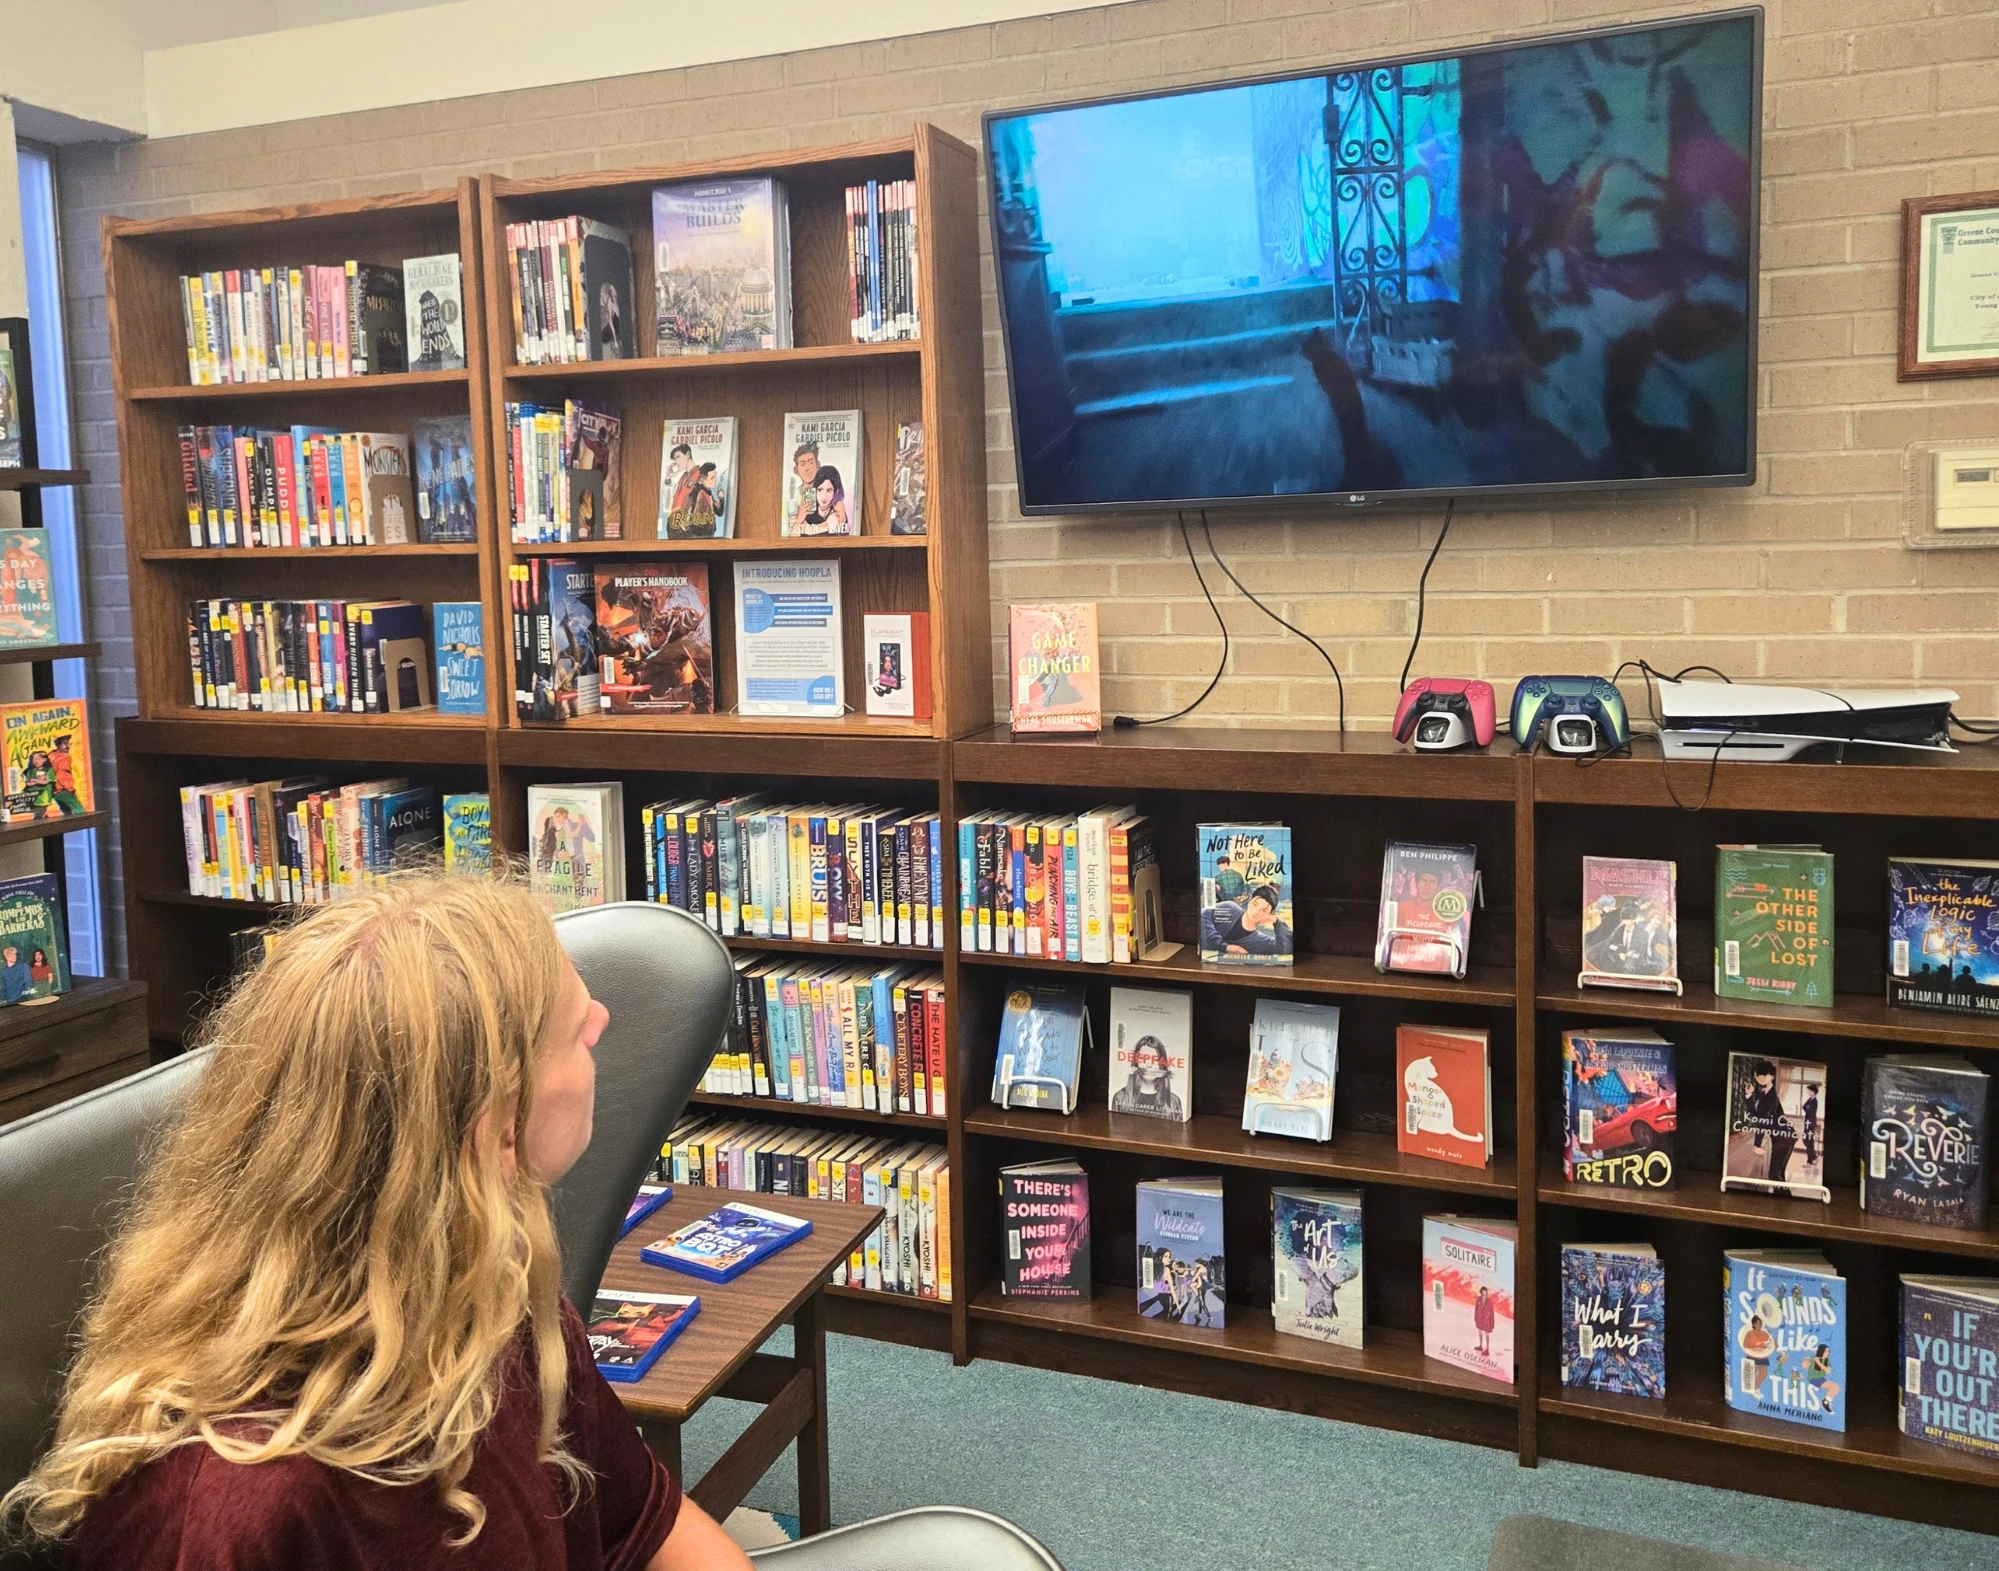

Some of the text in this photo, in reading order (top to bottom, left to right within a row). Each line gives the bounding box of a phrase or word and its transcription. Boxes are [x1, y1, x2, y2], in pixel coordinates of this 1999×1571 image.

[694, 187, 732, 197] MINECRAFT
[680, 197, 744, 213] MASTER
[686, 212, 741, 228] BUILDS
[1958, 229, 1984, 237] Greene
[407, 263, 453, 279] GERALDINE
[422, 308, 439, 320] THE
[421, 332, 450, 354] ENDS
[582, 414, 600, 428] CITY
[677, 424, 719, 436] KAMI GARCIA
[802, 422, 846, 432] KAMI GARCIA
[671, 434, 723, 446] GABRIEL PICOLO
[796, 432, 851, 443] GABRIEL PICOLO
[669, 511, 714, 531] ROBIN
[11, 559, 37, 570] DAY
[742, 566, 832, 578] INTRODUCING HOOPLA
[615, 576, 688, 588] PLAYER'S HANDBOOK
[444, 611, 474, 628] DAVID
[443, 626, 480, 645] NICHOLLS
[539, 615, 551, 665] STARTER SET
[1031, 631, 1076, 650] GAME
[447, 657, 480, 677] SWEET
[1018, 656, 1092, 675] CHANGER
[6, 706, 75, 730] ON AGAIN,
[1020, 714, 1094, 726] NEAL SHUSTERMAN
[6, 717, 80, 745] AWKWARD
[10, 735, 52, 769] AGAIN
[389, 806, 432, 829] ALONE
[462, 806, 484, 825] BOY
[185, 826, 193, 862] loveless
[561, 841, 566, 851] A
[667, 835, 680, 866] LOUDER
[1206, 833, 1264, 853] Not Here
[977, 836, 992, 876] Fable
[996, 828, 1007, 880] Namesake
[1234, 848, 1262, 860] to Be
[1400, 850, 1458, 862] BEN PHILIPPE
[536, 860, 592, 877] FRAGILE
[1244, 854, 1286, 882] Liked
[1064, 870, 1076, 894] BOYS
[1088, 862, 1100, 900] bridge
[1937, 878, 1960, 891] the
[1048, 855, 1058, 938] PUNCHING AIR
[1782, 888, 1818, 902] THE
[1903, 886, 1997, 908] Inexplicable
[1443, 899, 1456, 911] M
[1755, 903, 1818, 918] OTHER
[1930, 904, 1976, 924] Logic
[1066, 904, 1078, 938] BEAST
[1776, 920, 1818, 934] SIDE
[1930, 925, 1972, 941] of my
[1793, 937, 1818, 950] OF
[1922, 932, 1981, 957] Life
[1771, 952, 1818, 968] LOST
[1746, 976, 1797, 990] JESSI KIRBY
[1898, 988, 1971, 1008] BENJAMIN ALIRE
[842, 1016, 854, 1059] ALL MY
[911, 1003, 924, 1062] CONCRETE
[932, 1002, 940, 1056] THE HATE
[896, 1012, 908, 1098] CEMETERY BOYS
[1118, 1051, 1185, 1069] DEEPFAKE
[1614, 1063, 1668, 1074] SHUSTERMAN
[1412, 1095, 1446, 1109] Shaped
[1416, 1106, 1443, 1120] Space
[1744, 1110, 1774, 1126] Komi
[1733, 1120, 1820, 1141] Communicate
[1426, 1146, 1446, 1157] wendy
[1873, 1118, 1980, 1178] REVERIE
[1577, 1150, 1672, 1188] RETRO
[1014, 1179, 1072, 1197] THERE'S
[1894, 1189, 1927, 1207] RYAN
[1007, 1202, 1079, 1218] SOMEONE
[1173, 1210, 1182, 1218] ARE
[1021, 1224, 1066, 1240] INSIDE
[1154, 1213, 1206, 1236] Wildcats
[1290, 1218, 1342, 1250] The Art
[682, 1239, 732, 1256] BOT
[694, 1232, 742, 1247] ASTRO
[903, 1236, 911, 1268] KYOSHI
[923, 1240, 932, 1272] KYOSHI
[1025, 1243, 1067, 1260] YOUR
[1310, 1247, 1338, 1271] Us
[1445, 1245, 1492, 1268] SOLITAIRE
[1020, 1262, 1072, 1282] HOUSE
[1748, 1267, 1766, 1291] It
[1010, 1288, 1080, 1296] STEPHANIE PERKINS
[1574, 1294, 1648, 1328] What I
[1738, 1291, 1837, 1328] SOUNDS
[1294, 1318, 1340, 1341] Julie Wright
[1953, 1310, 1980, 1340] IF
[1586, 1329, 1654, 1357] arry
[1776, 1327, 1818, 1352] Like
[1440, 1344, 1498, 1368] ALICE OSEMAN
[1769, 1374, 1820, 1412] THIS
[1936, 1369, 1993, 1406] OUT
[1757, 1402, 1823, 1422] ANNA MERIANO
[1925, 1426, 1944, 1437] KATY
